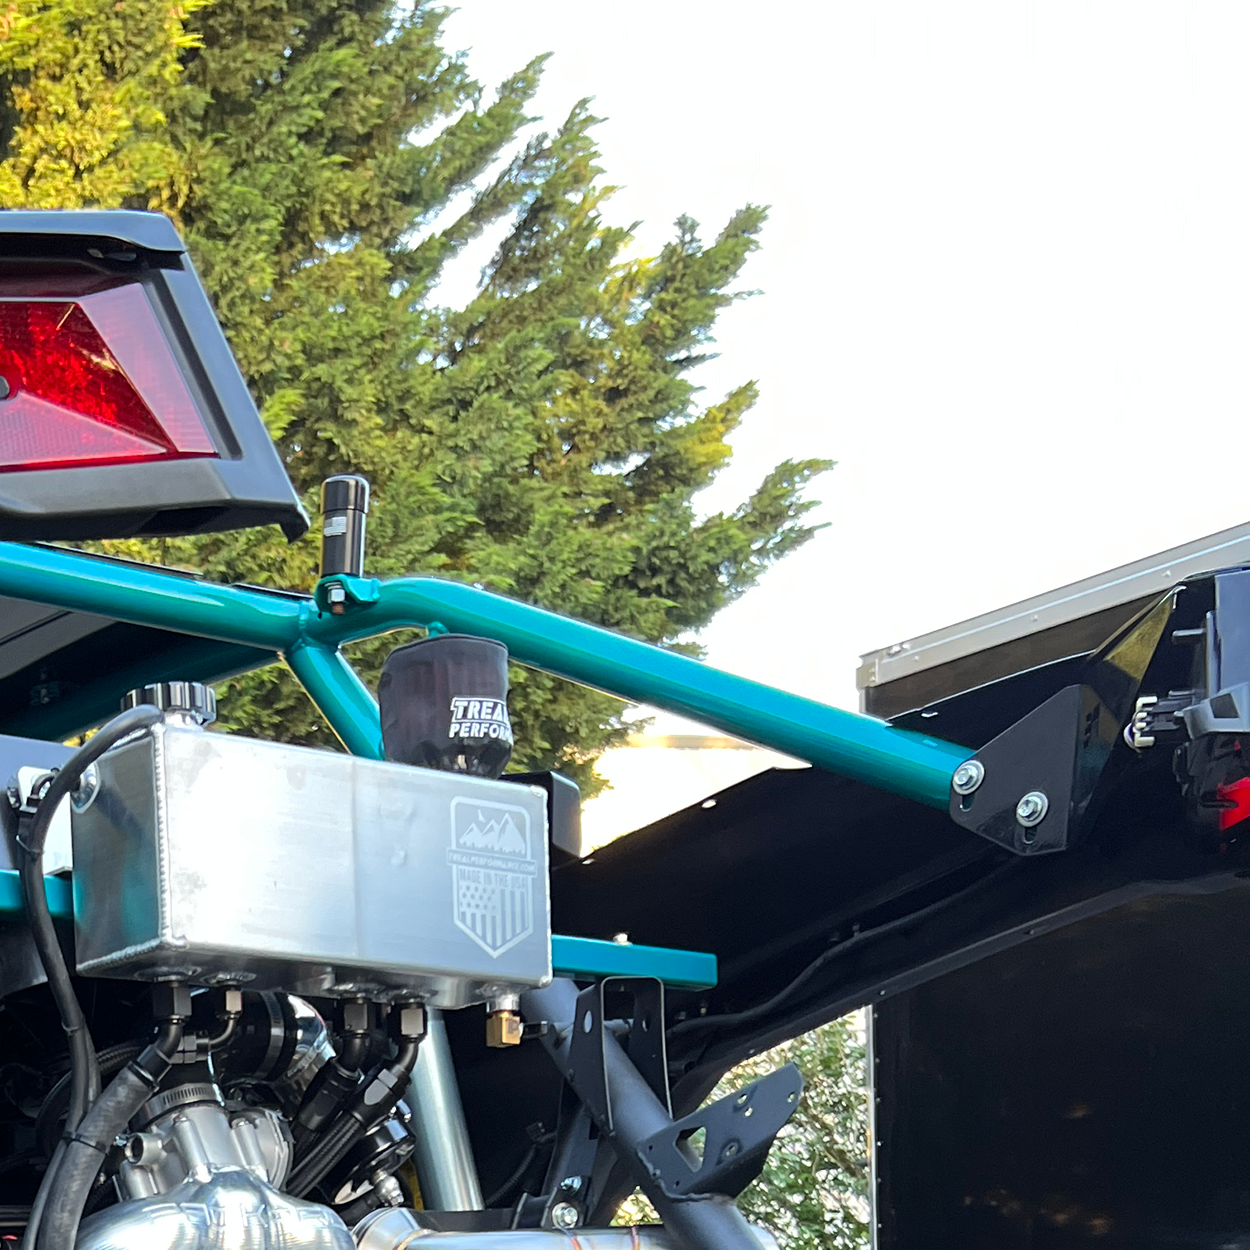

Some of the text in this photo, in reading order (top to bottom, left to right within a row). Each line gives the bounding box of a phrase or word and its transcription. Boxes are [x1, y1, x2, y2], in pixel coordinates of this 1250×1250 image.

[459, 868, 528, 889] MADE IN THE USA
